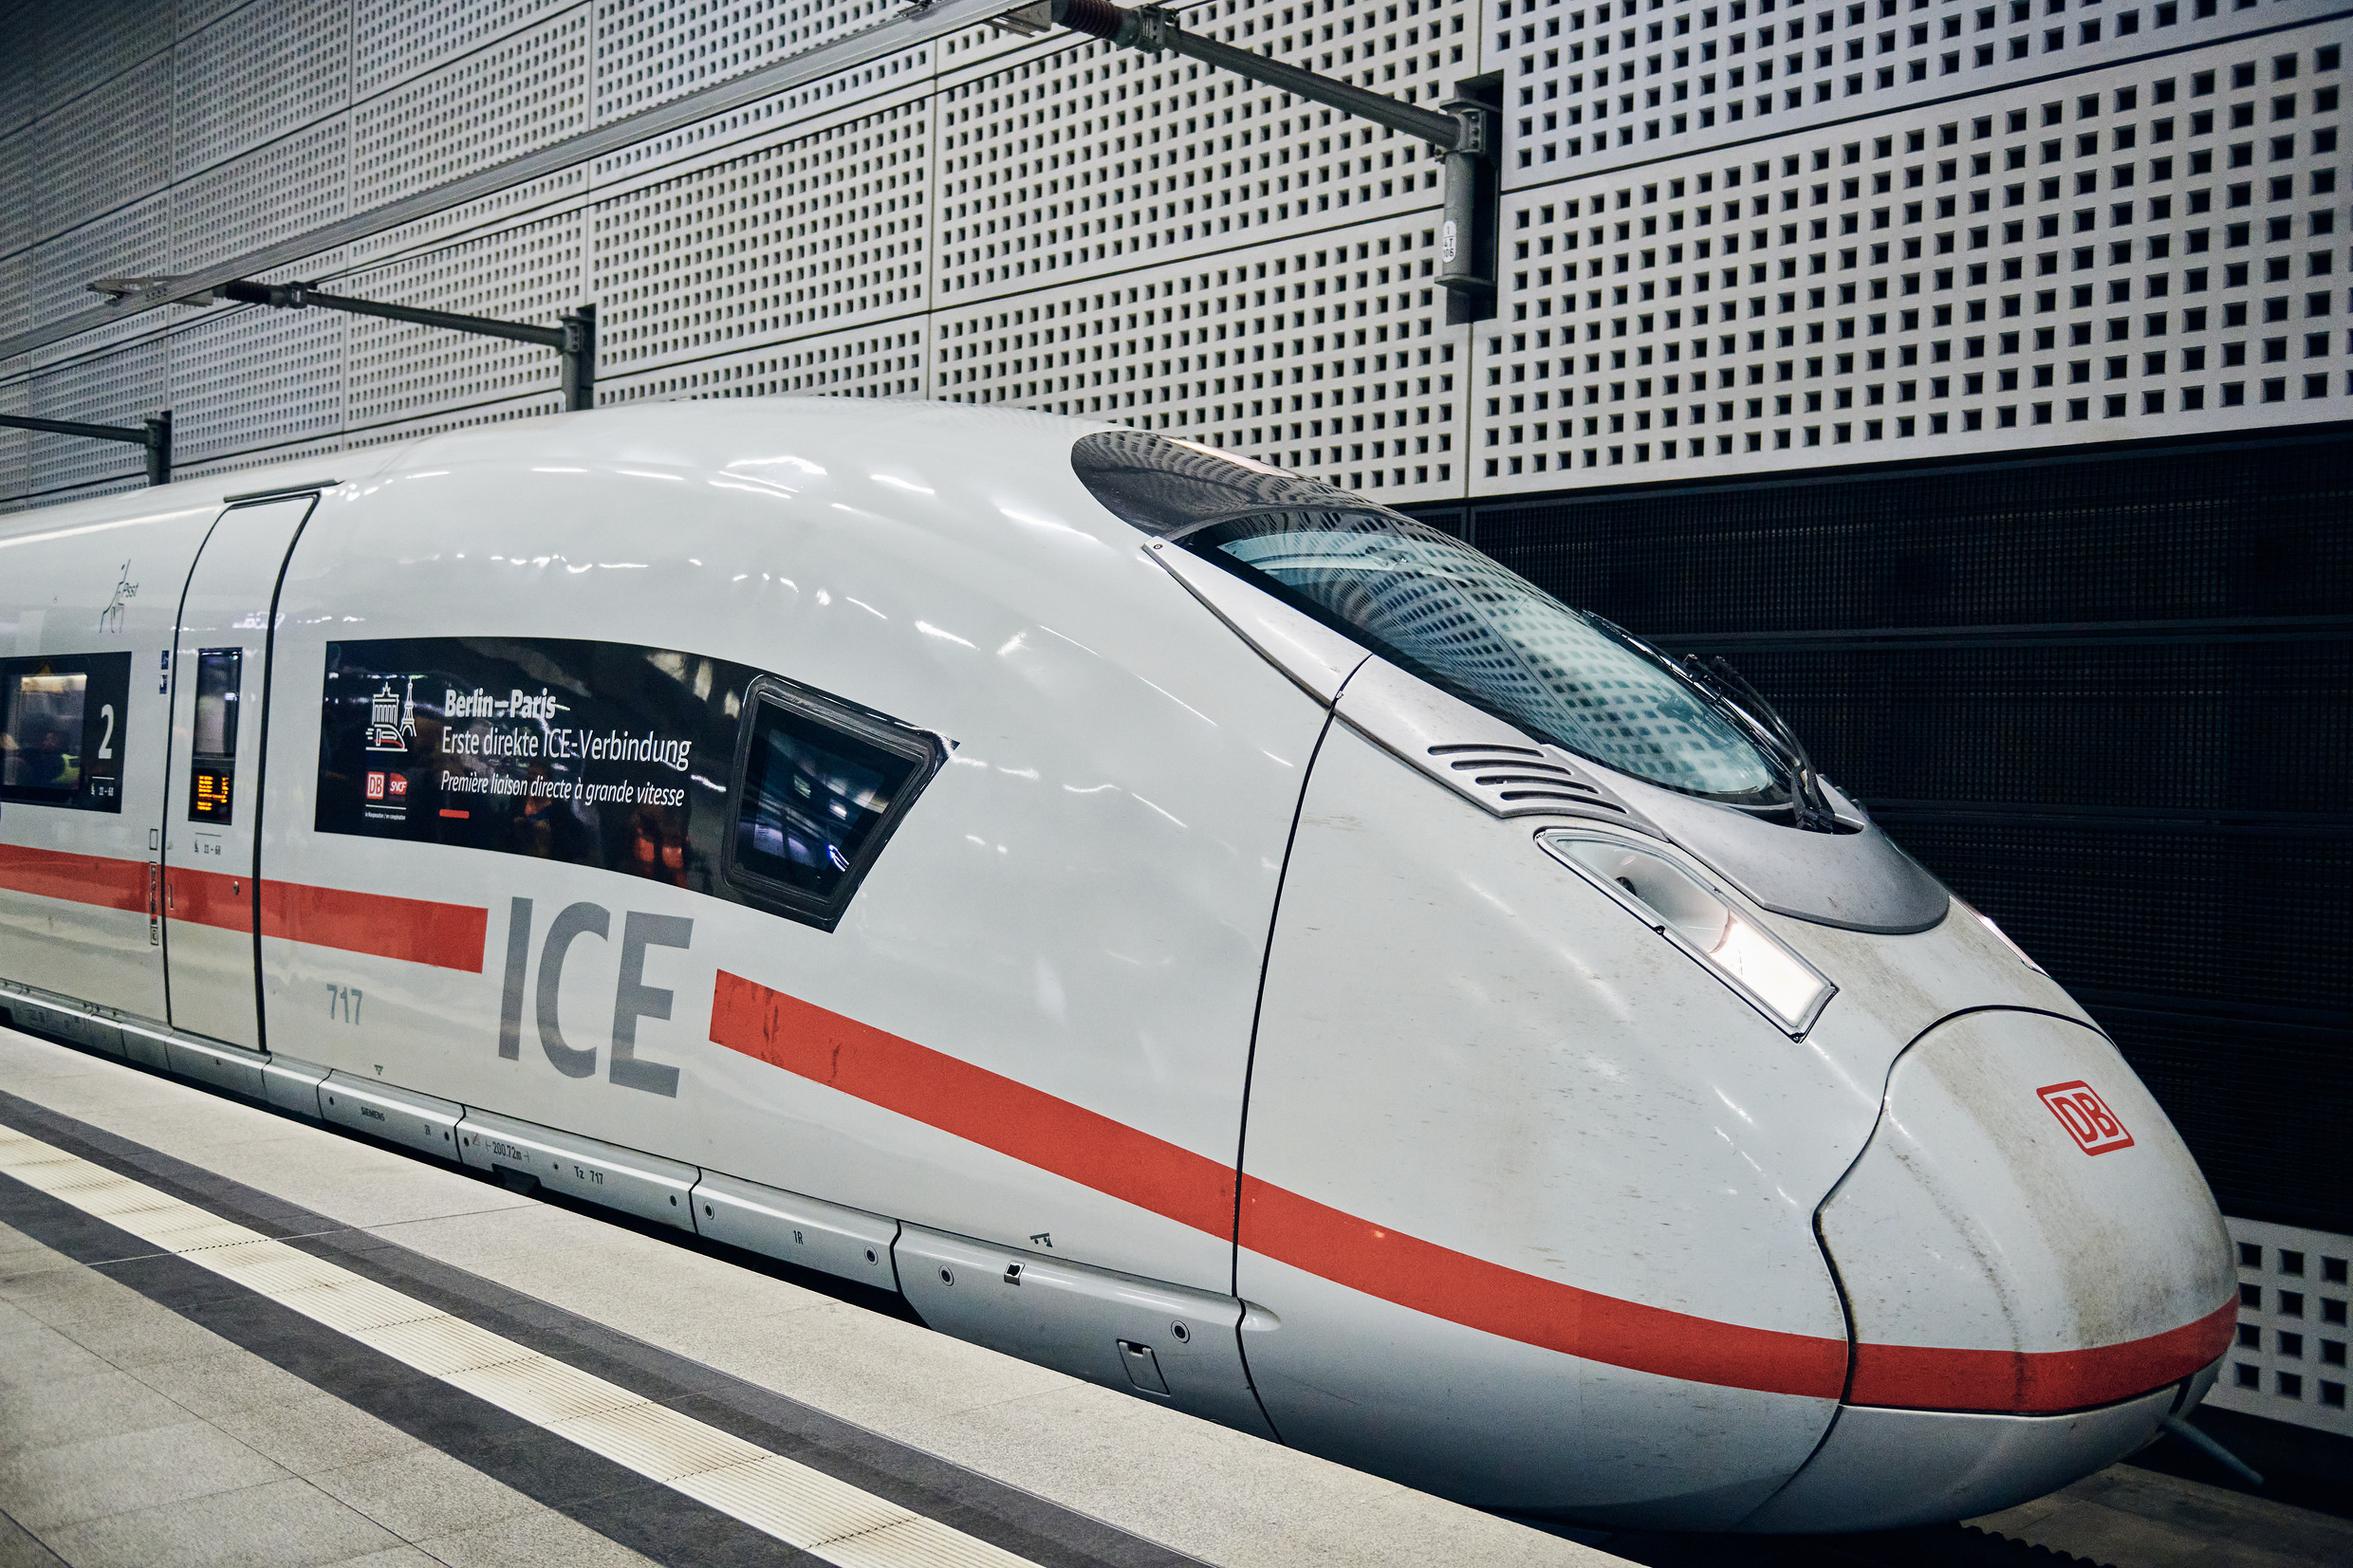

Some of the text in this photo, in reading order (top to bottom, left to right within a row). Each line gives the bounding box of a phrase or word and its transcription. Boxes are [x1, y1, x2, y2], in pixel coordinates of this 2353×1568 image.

[98, 704, 114, 759] 2
[442, 726, 693, 771] Erste direkte ICE-Verbindung
[440, 769, 685, 806] Première liaison directe à grande vitesse
[325, 983, 363, 1026] 717
[498, 895, 695, 1099] ICE
[361, 1106, 385, 1121] SIEMENS
[2047, 1090, 2121, 1146] DB
[589, 1170, 604, 1185] 717
[793, 1229, 804, 1245] 1R
